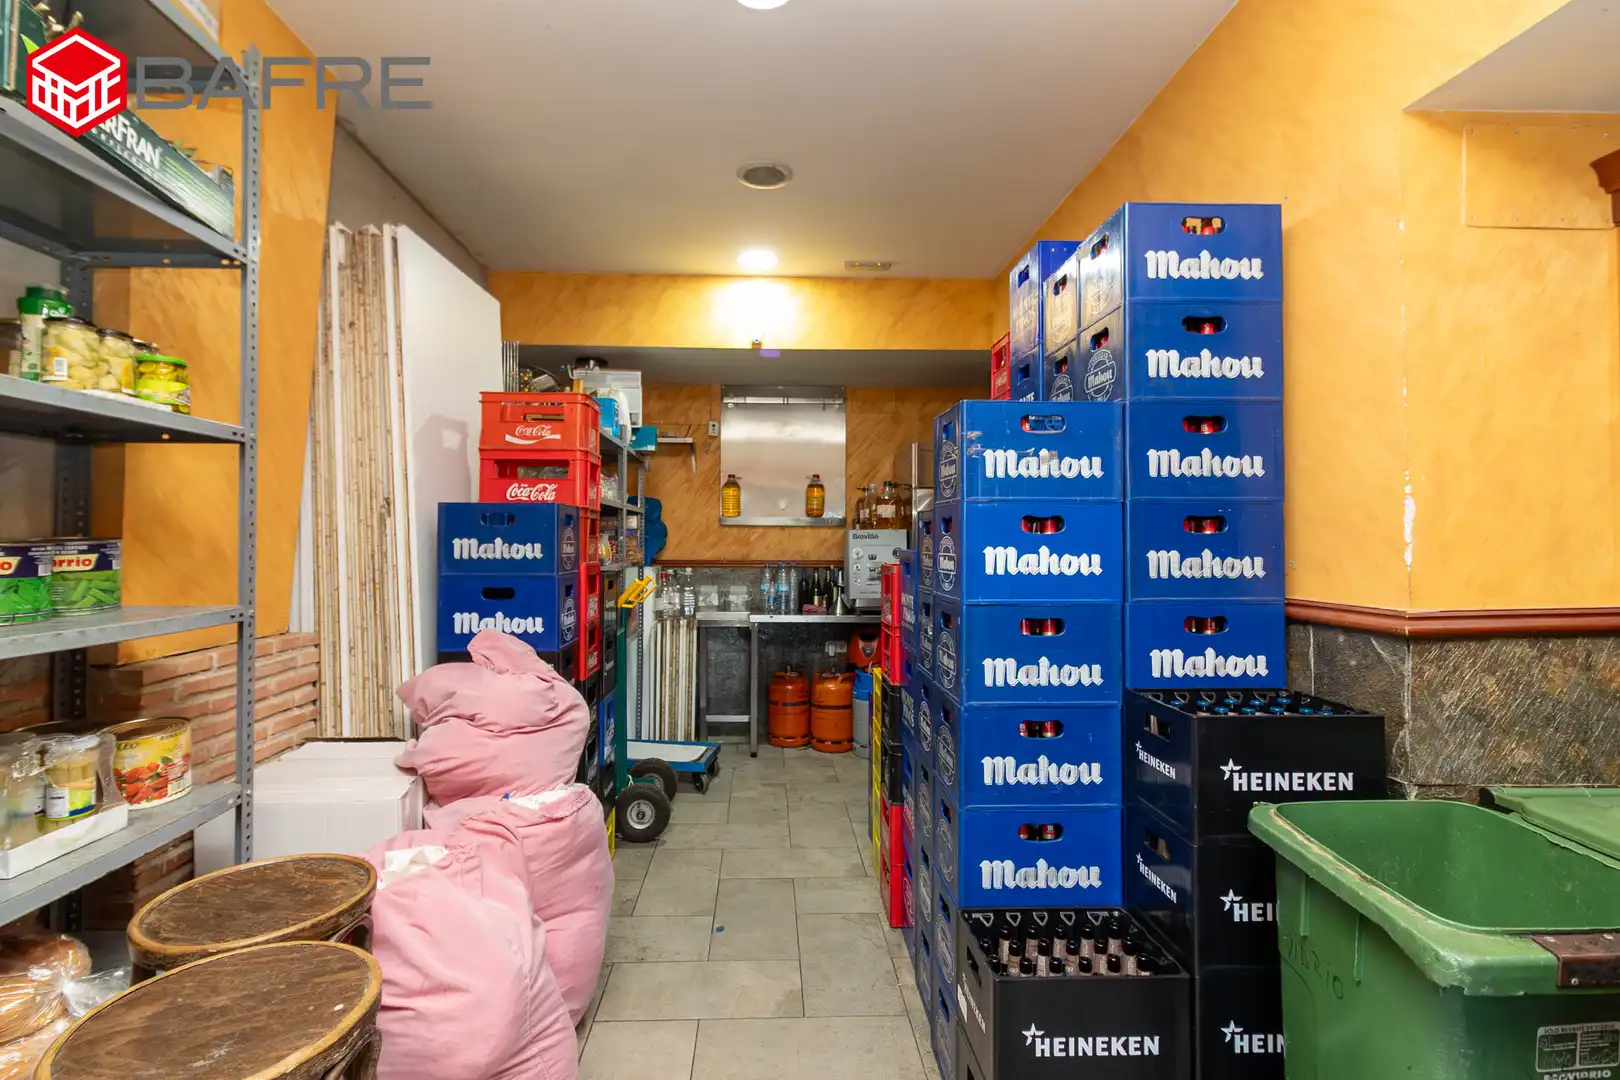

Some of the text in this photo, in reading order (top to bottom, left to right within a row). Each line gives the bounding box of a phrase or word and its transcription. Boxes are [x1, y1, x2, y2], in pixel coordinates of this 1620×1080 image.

[1144, 250, 1264, 279] Mahou
[1146, 348, 1264, 378] Mahou
[983, 448, 1104, 478] Mahou
[1147, 447, 1265, 477] Mahou
[453, 538, 543, 559] Mahou
[983, 545, 1103, 575] Mahou
[1146, 549, 1266, 578] Mahou
[453, 612, 544, 634] Mahou
[982, 656, 1104, 687] Mahou
[1149, 648, 1268, 677] Mahou
[981, 755, 1103, 785] Mahou
[1138, 749, 1176, 780] HEINEKEN
[1232, 772, 1354, 791] HEINEKEN
[979, 859, 1102, 889] Mahou
[1139, 861, 1177, 903] HEINEKEN
[1233, 903, 1279, 922] HEI
[1034, 1036, 1160, 1057] HEINEKEN
